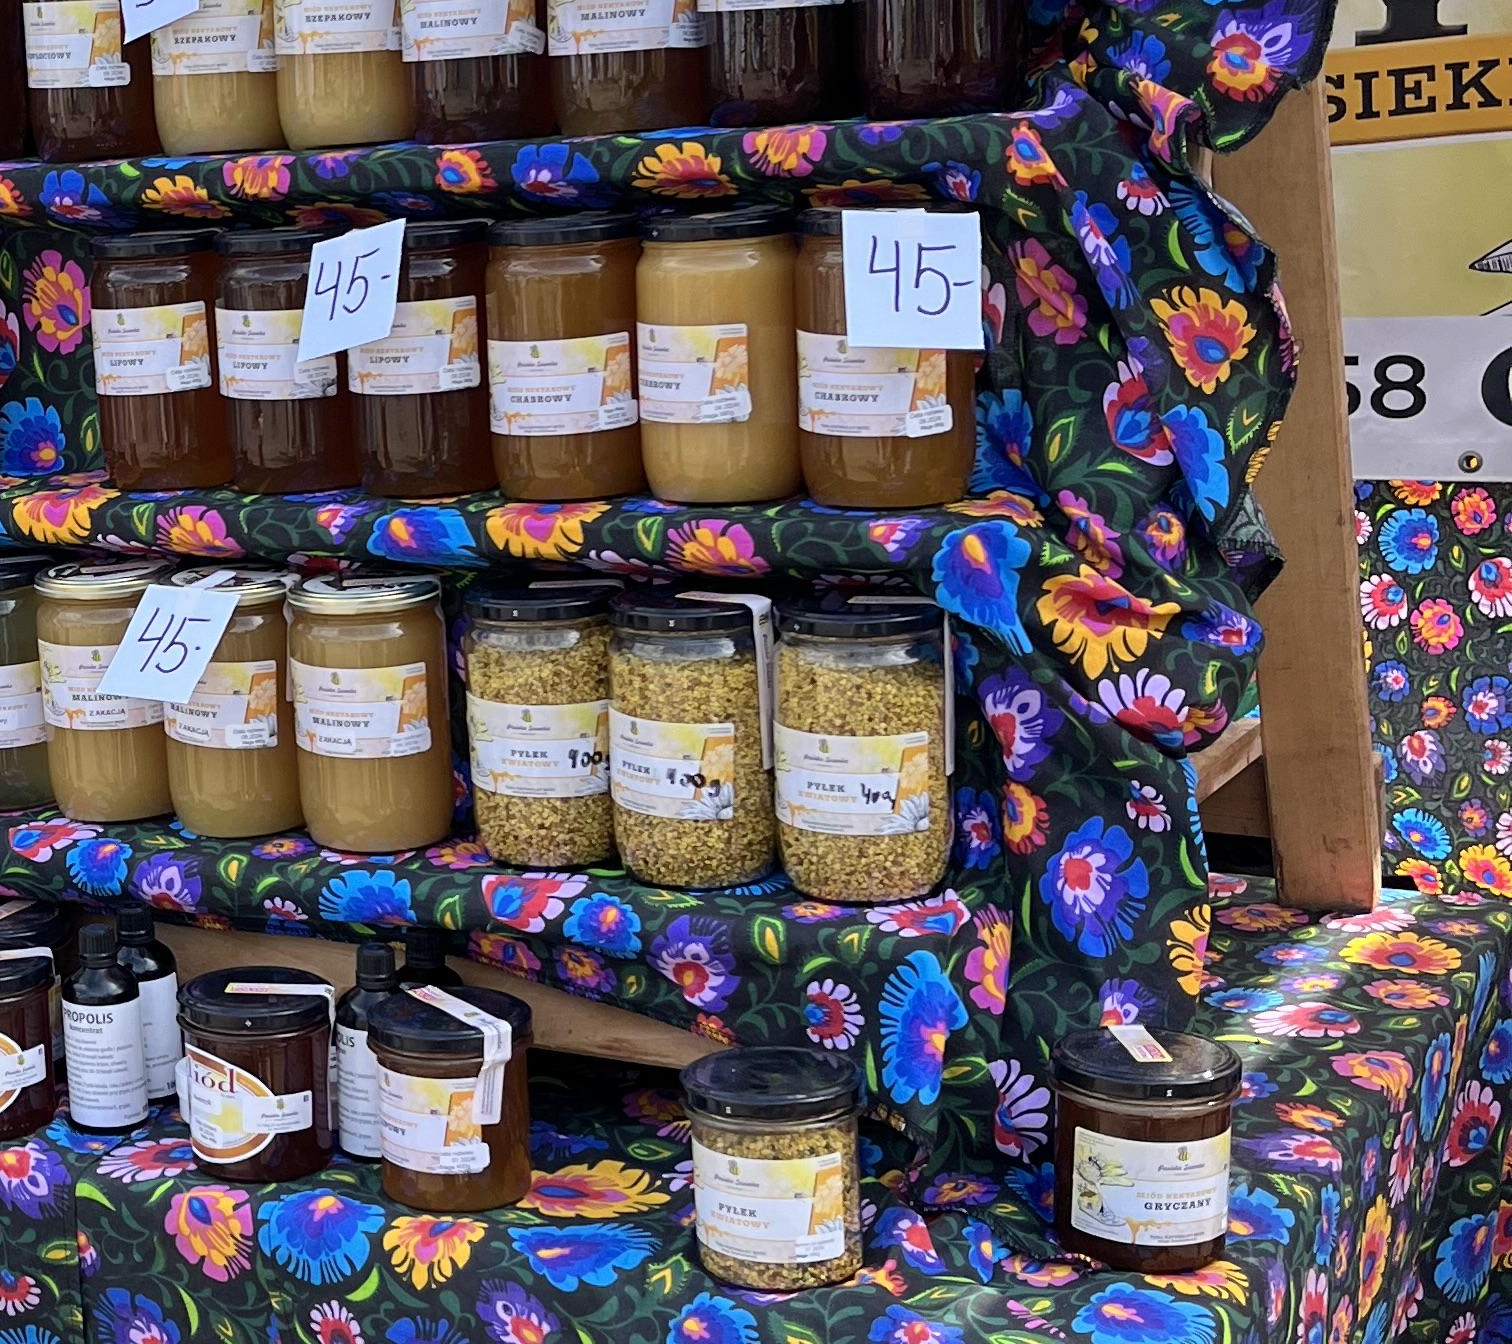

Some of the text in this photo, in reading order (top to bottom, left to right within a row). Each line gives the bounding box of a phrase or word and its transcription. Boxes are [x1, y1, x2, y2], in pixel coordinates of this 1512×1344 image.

[304, 12, 372, 24] RZEPAKOWY
[580, 8, 646, 22] MALINOWY
[420, 17, 479, 29] MALINOWY
[174, 34, 238, 45] RZEPAKOWY
[1325, 58, 1512, 123] SIEK
[109, 359, 144, 368] LIPOWY
[232, 361, 268, 370] LIPOWY
[369, 355, 410, 365] LIPOWY
[510, 394, 573, 404] CHABROWY
[814, 391, 880, 404] CHABROWY
[312, 717, 370, 729] MALINOWY
[510, 749, 548, 759] PYŁEK
[807, 781, 846, 793] PYŁEK
[63, 1007, 114, 1025] PROPOLIS
[188, 1064, 236, 1094] iód
[718, 1202, 757, 1218] PYŁEK
[1144, 1197, 1211, 1211] GRYCZANY
